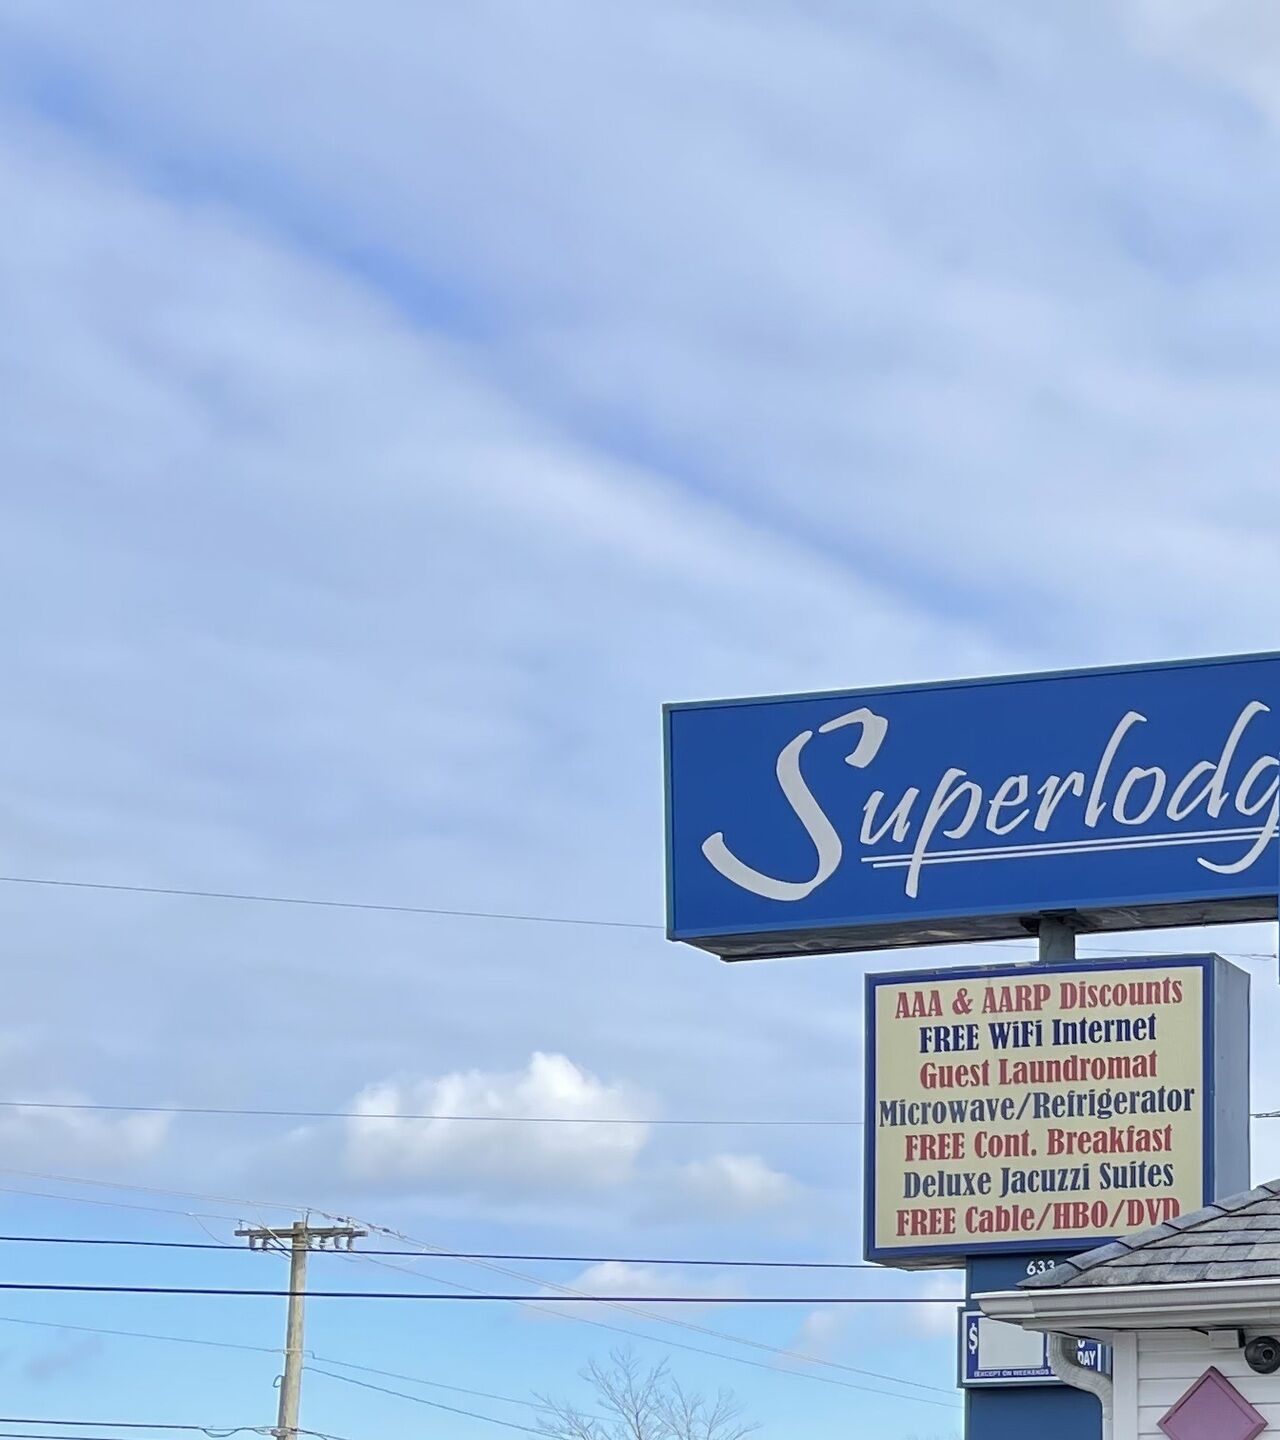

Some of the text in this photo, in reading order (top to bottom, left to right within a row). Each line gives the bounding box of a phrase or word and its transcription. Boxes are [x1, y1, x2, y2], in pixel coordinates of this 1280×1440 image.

[894, 976, 1183, 1019] AAA & AARP Discounts
[919, 1013, 1157, 1053] FREE WiFi Internet
[919, 1050, 1158, 1089] Guest Laundromat
[879, 1086, 1196, 1128] Microwave/Refrigerator
[904, 1124, 1173, 1162] FREE Cont. Breakfast
[902, 1160, 1174, 1199] Deluxe Jacuzzi Suites
[895, 1196, 1181, 1237] FREE Cable/HBO/DVD
[968, 1322, 978, 1355] $
